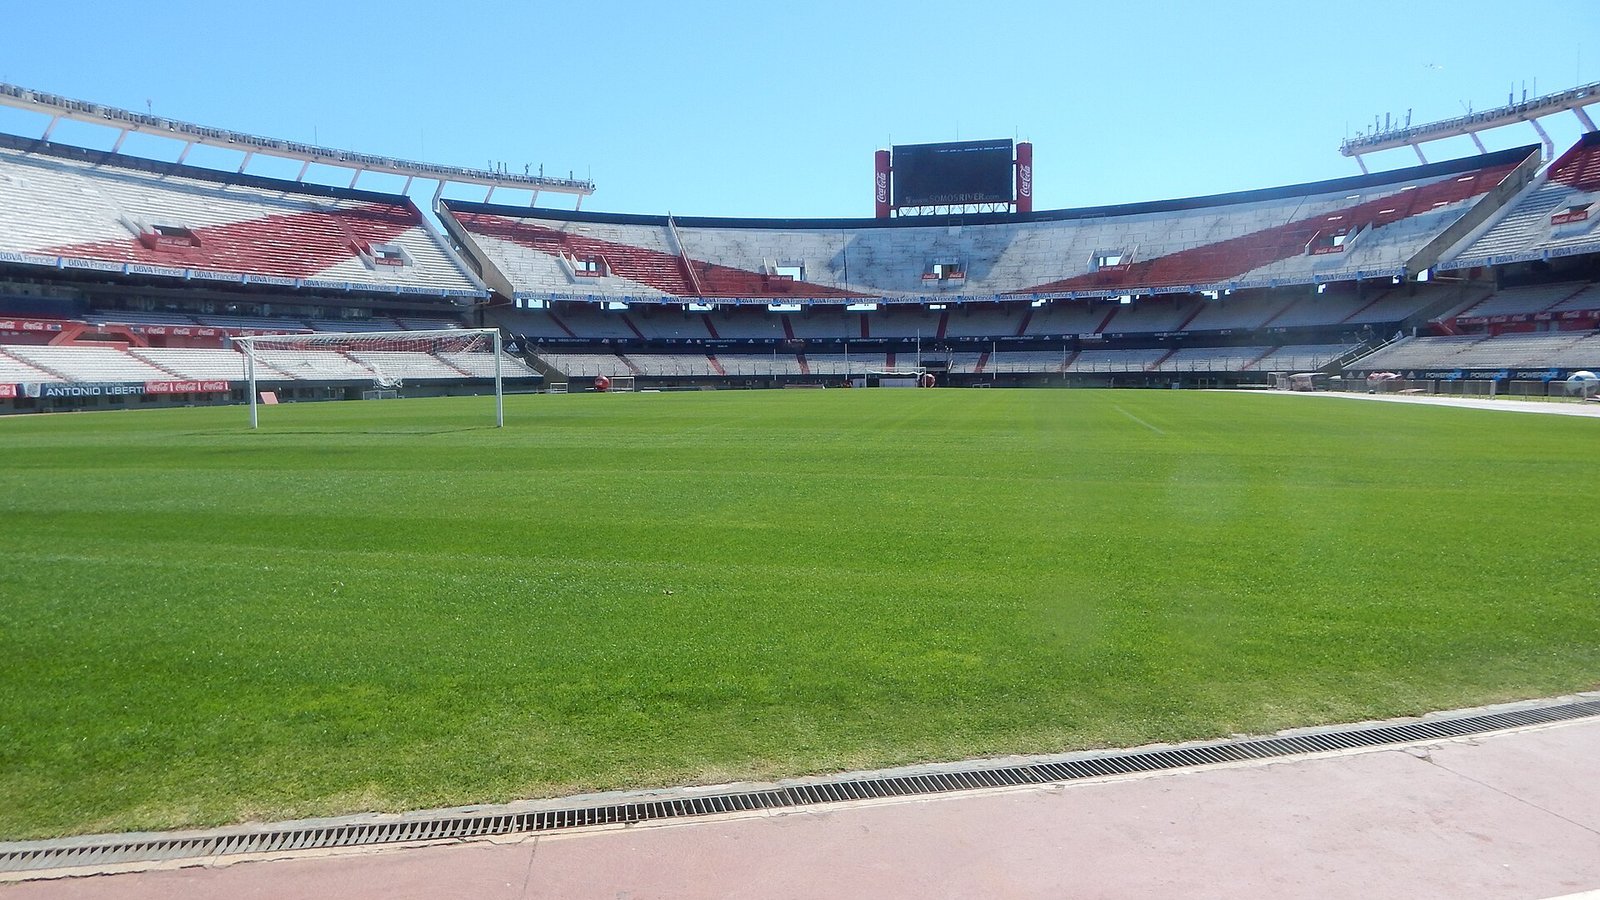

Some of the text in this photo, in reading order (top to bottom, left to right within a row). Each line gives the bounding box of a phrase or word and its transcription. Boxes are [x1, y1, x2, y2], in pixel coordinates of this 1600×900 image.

[1020, 164, 1031, 197] Coca-Cola
[876, 172, 887, 203] Coca-Cola
[1470, 371, 1508, 379] POWERADE
[175, 382, 197, 391] Coca-Cola
[203, 381, 224, 390] Coca-Cola
[46, 387, 101, 396] ANTONIO
